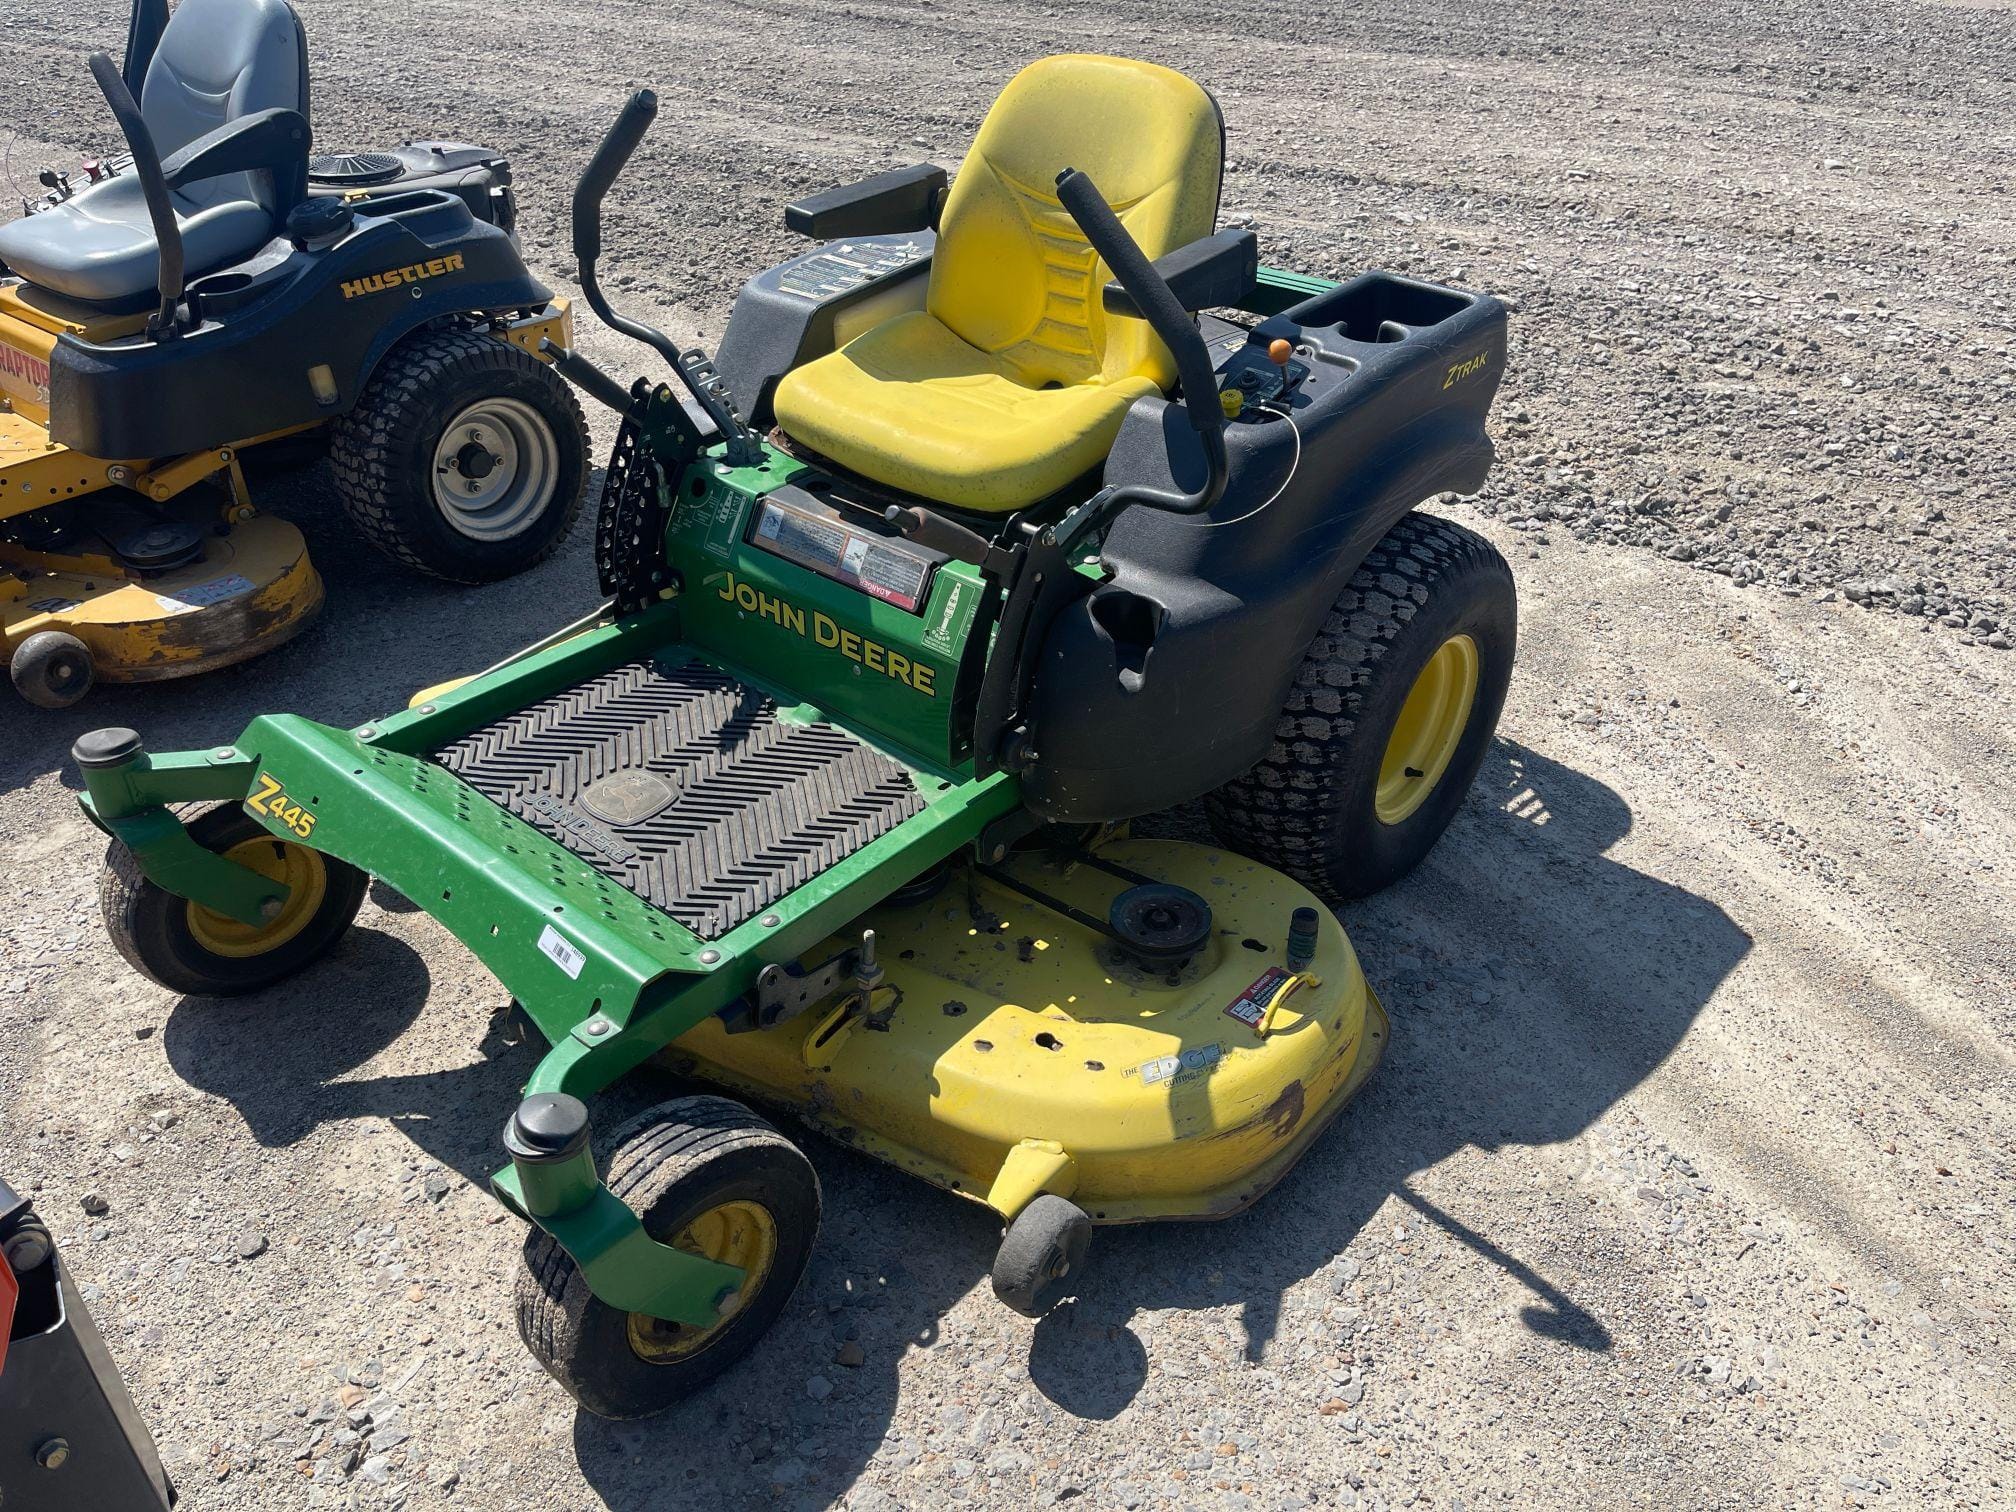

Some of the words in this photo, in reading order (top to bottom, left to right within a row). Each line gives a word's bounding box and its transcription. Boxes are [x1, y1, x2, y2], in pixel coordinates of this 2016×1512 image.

[341, 254, 464, 298] HUSTLER
[1442, 350, 1489, 390] ZTRAK
[859, 579, 885, 595] DANGER
[717, 571, 806, 637] JOHN
[813, 609, 936, 697] DEERE
[246, 774, 316, 838] Z445
[521, 791, 580, 829] JOHN
[565, 816, 637, 864] DEERE
[1124, 1066, 1138, 1077] THE
[1140, 1042, 1221, 1084] EDGE
